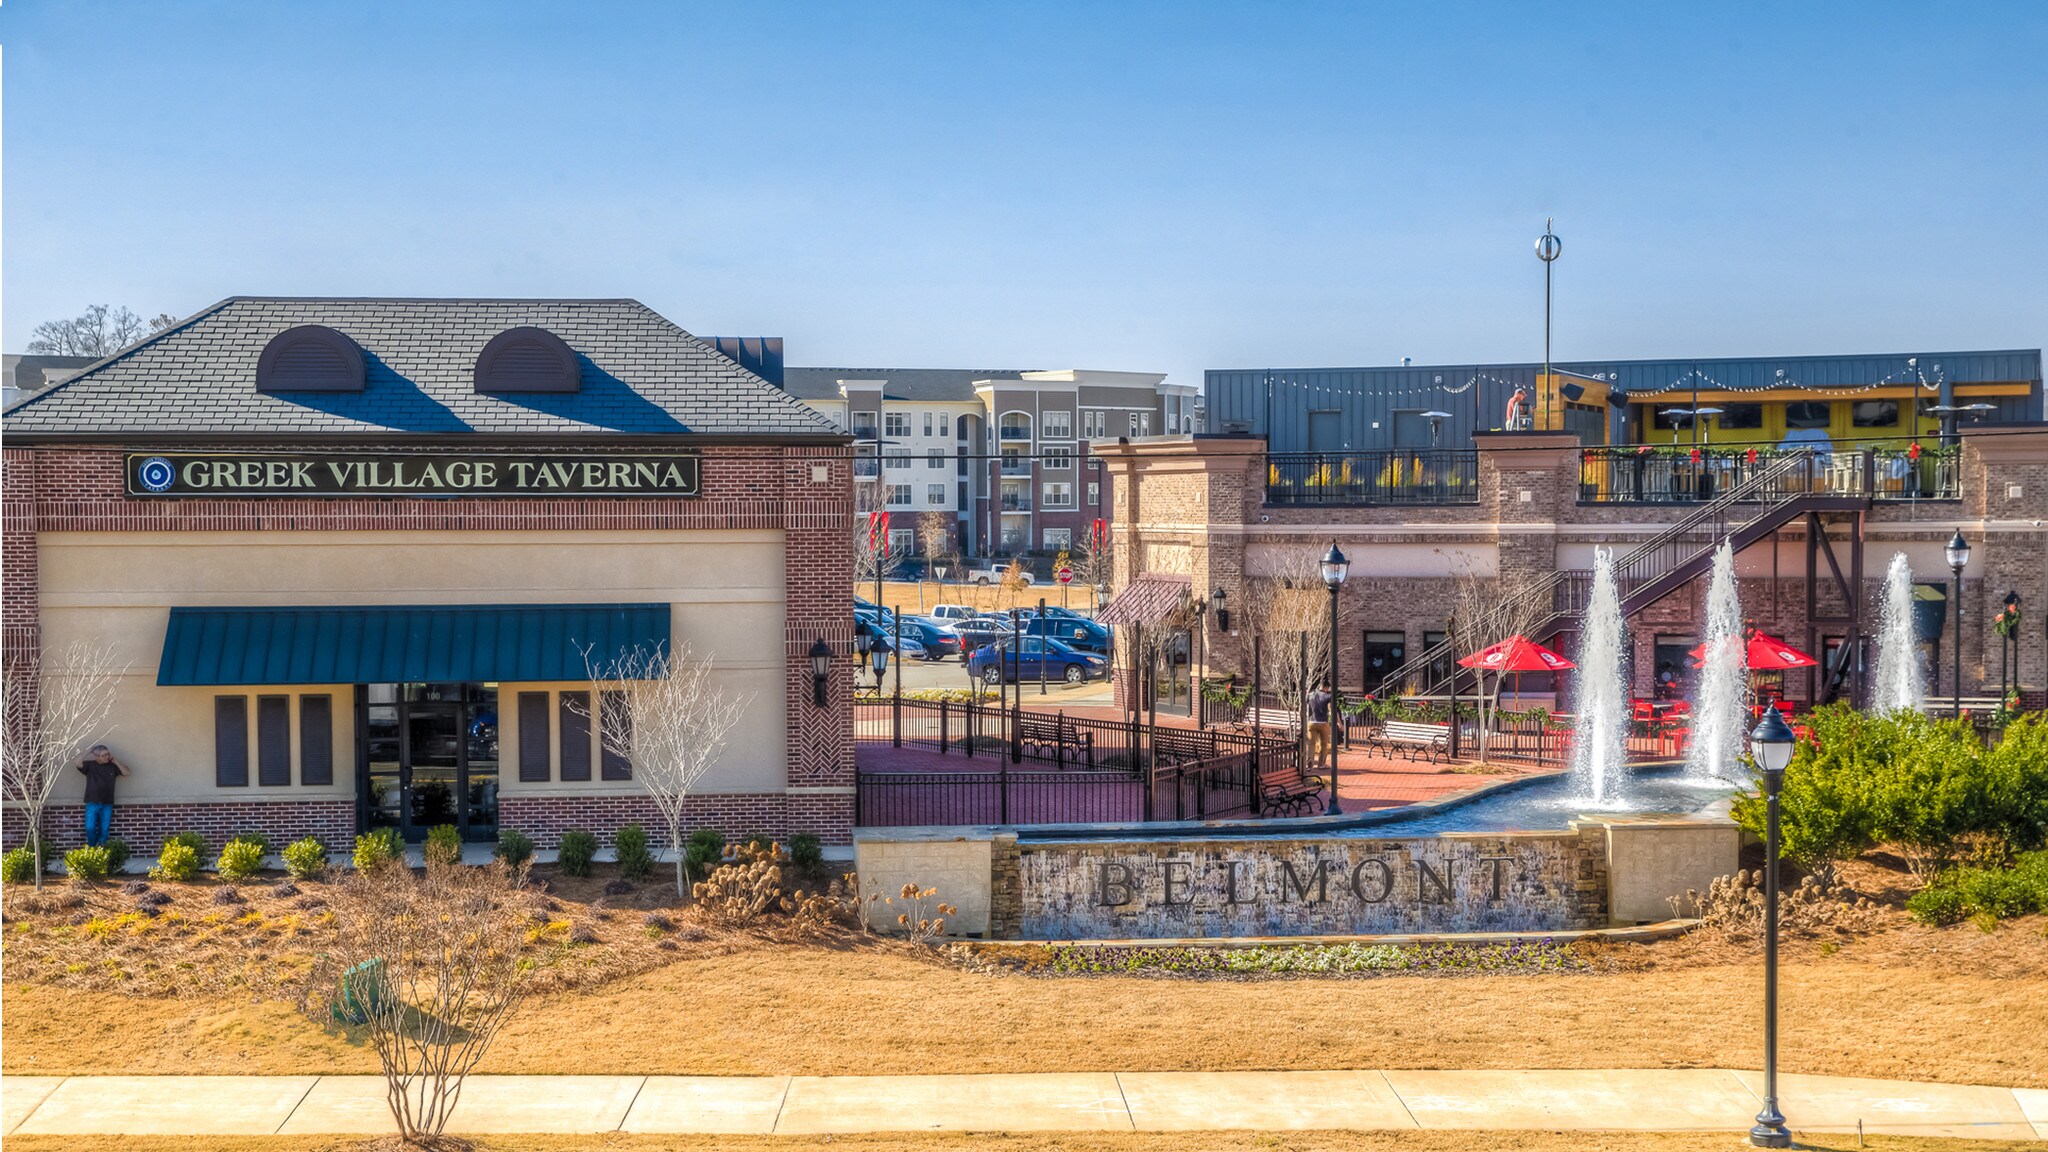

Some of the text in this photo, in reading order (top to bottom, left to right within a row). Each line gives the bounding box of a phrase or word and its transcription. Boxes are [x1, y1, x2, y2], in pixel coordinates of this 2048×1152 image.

[182, 461, 316, 488] GREEK
[326, 461, 498, 488] VILLAGE
[508, 461, 687, 488] TAVERNA
[427, 692, 440, 700] 100
[1099, 857, 1516, 907] BELMONT
